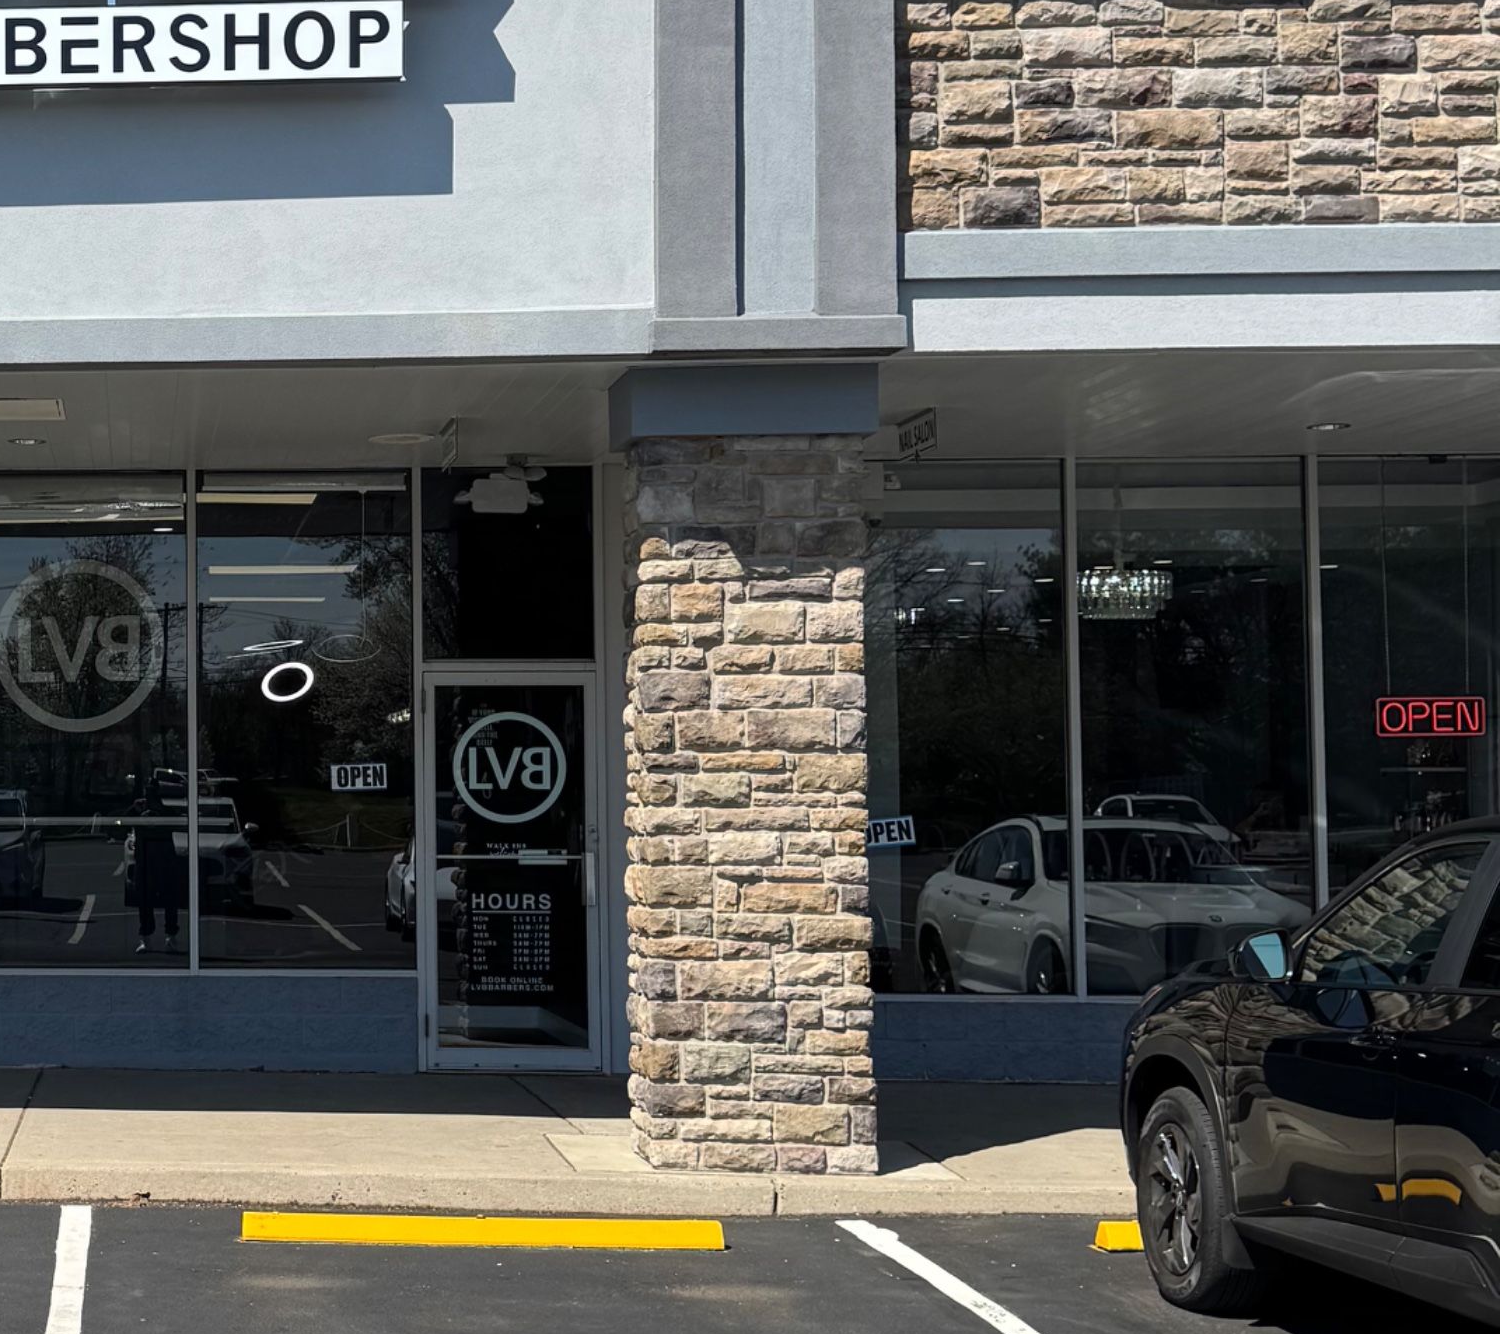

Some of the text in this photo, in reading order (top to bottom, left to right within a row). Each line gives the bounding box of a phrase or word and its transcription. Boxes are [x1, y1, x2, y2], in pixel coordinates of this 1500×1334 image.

[1381, 700, 1480, 733] OPEN
[337, 764, 385, 788] OPEN
[471, 892, 552, 910] HOURS
[481, 976, 544, 985] BOOK ONLINE
